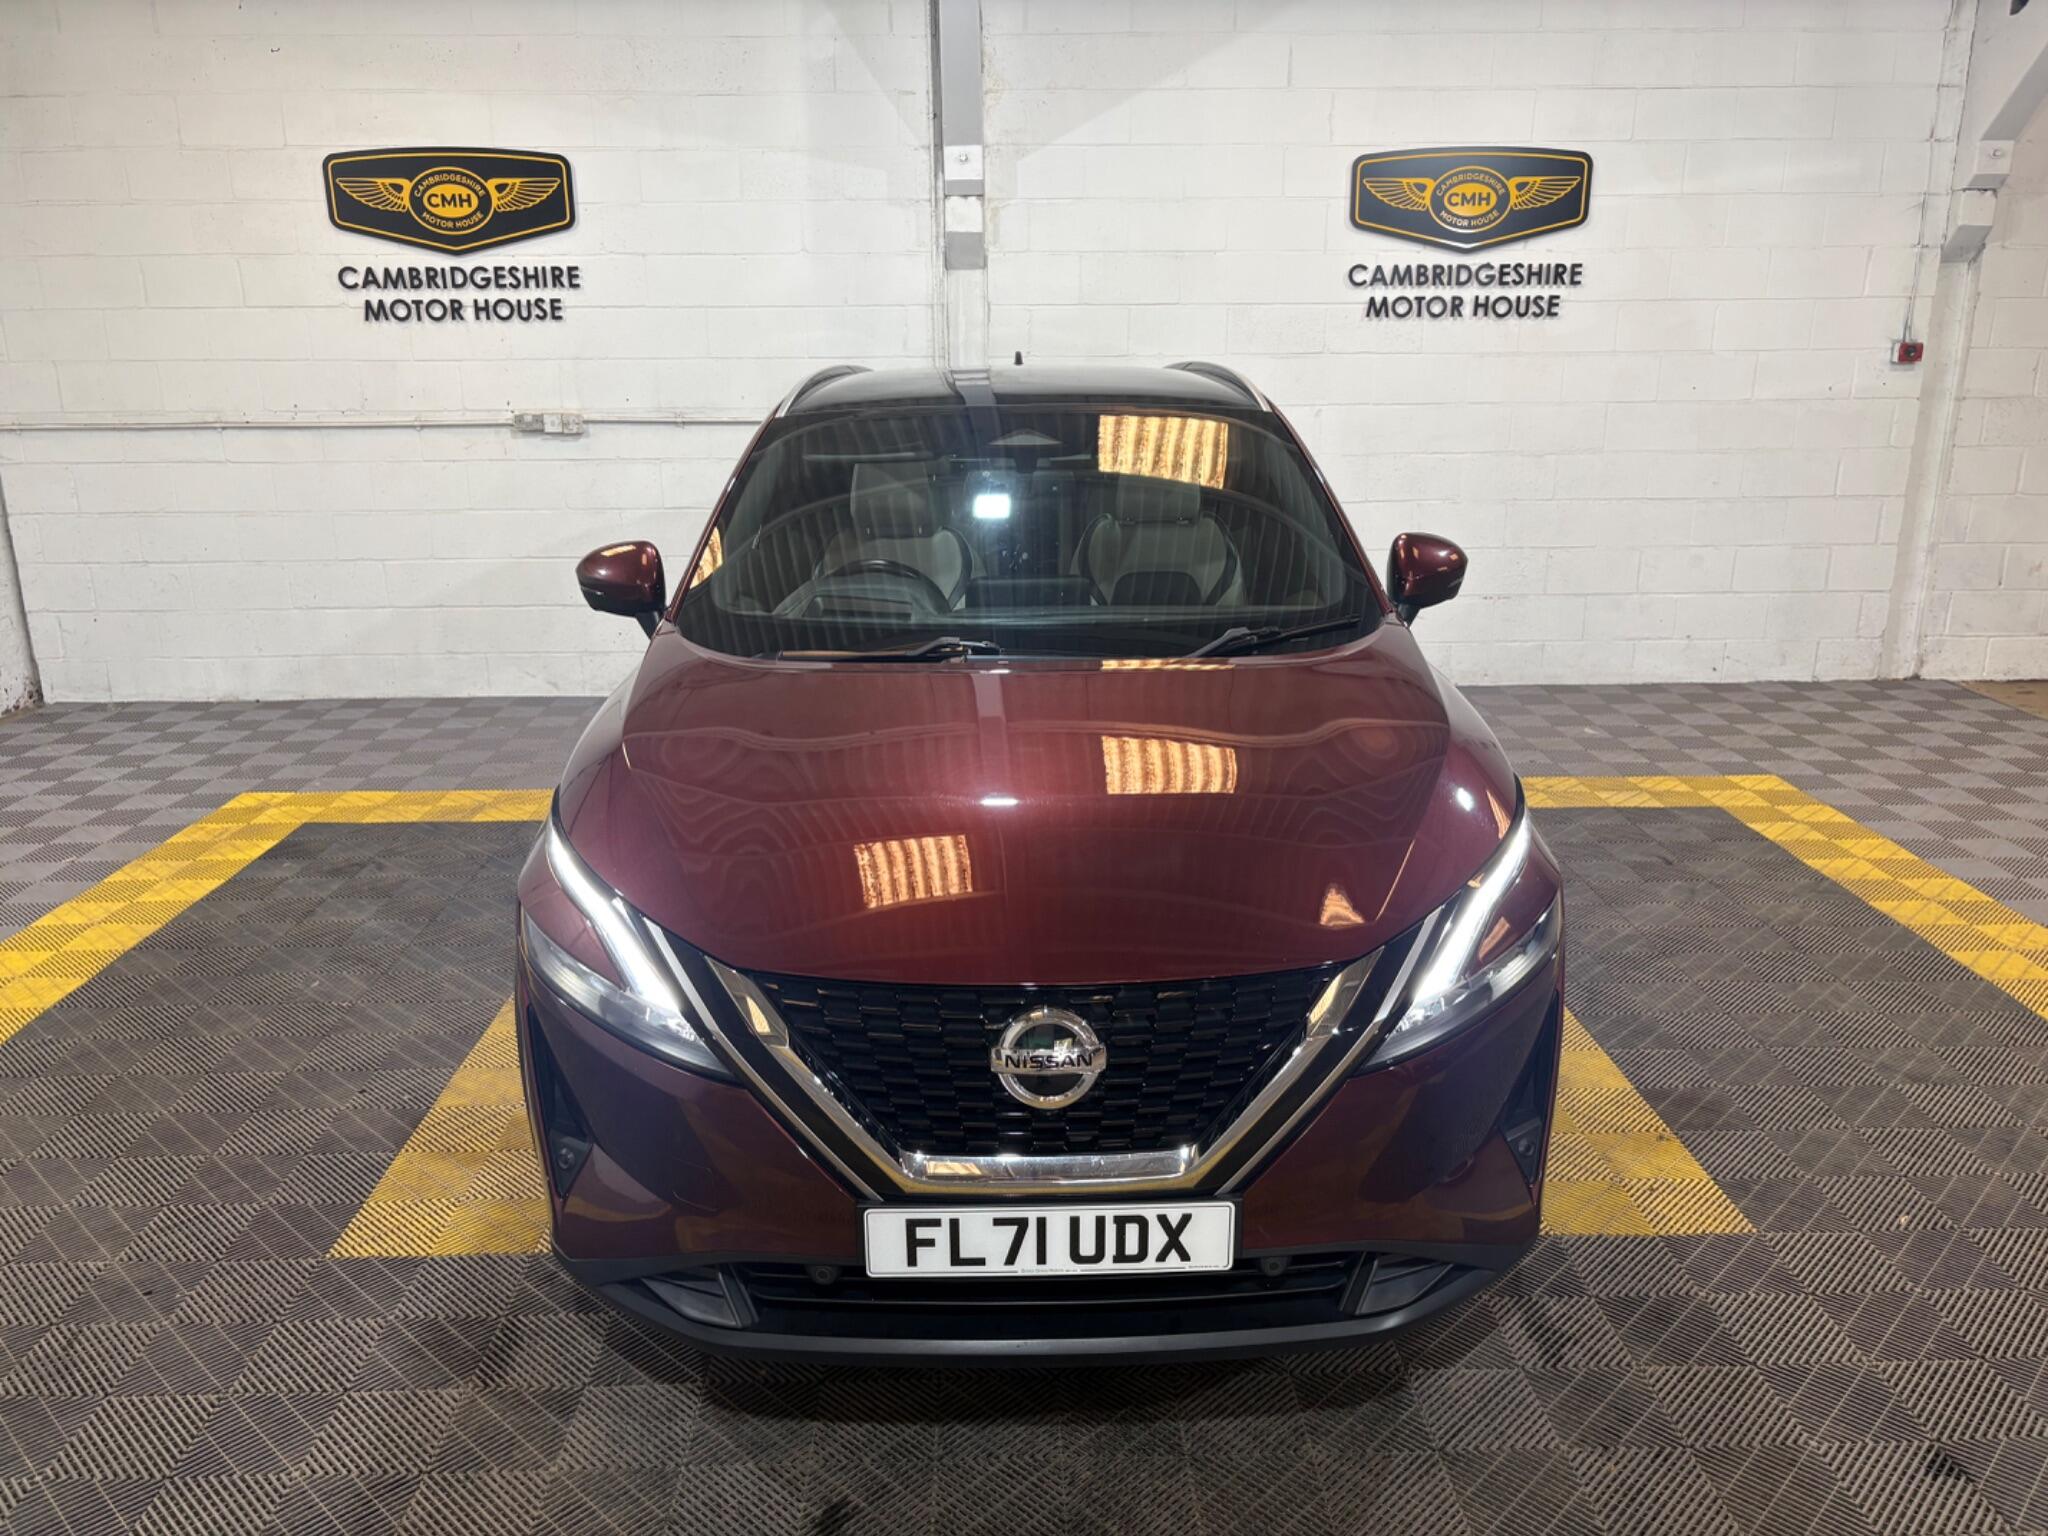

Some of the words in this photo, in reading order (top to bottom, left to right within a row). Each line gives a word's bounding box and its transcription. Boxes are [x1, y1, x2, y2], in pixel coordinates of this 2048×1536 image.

[414, 173, 487, 197] CAMBRIDGESHIRE
[1436, 172, 1506, 196] CAMBRIDGESHIRE
[427, 193, 472, 208] CMH
[1448, 192, 1491, 206] CMH
[422, 211, 454, 228] MOTOR
[455, 211, 484, 228] HOUSE
[1440, 210, 1469, 227] MOTOR
[1471, 209, 1500, 226] HOUSE
[338, 266, 581, 290] CAMBRIDGESHIRE
[1348, 263, 1583, 287] CAMBRIDGESHIRE
[364, 299, 464, 321] MOTOR
[474, 298, 563, 321] HOUSE
[1365, 296, 1464, 318] MOTOR
[1473, 295, 1560, 317] HOUSE
[1004, 1054, 1093, 1069] NISSAN
[905, 1216, 1047, 1267] FL71
[1069, 1213, 1193, 1265] UDX
